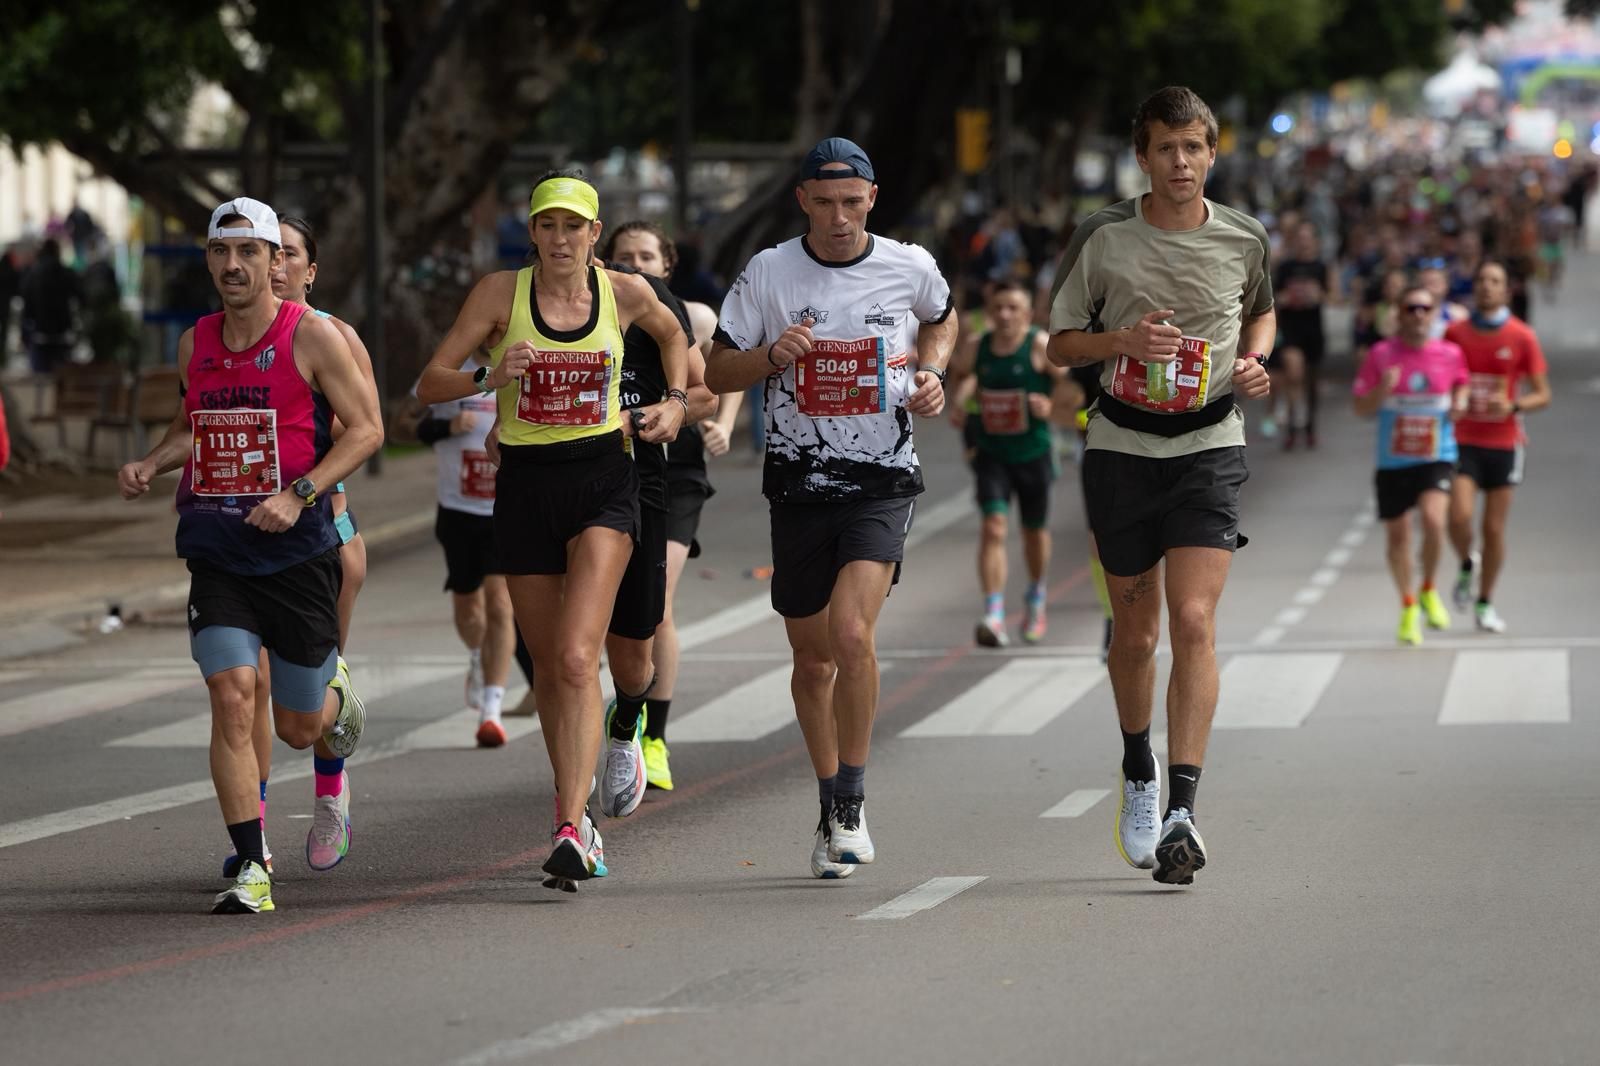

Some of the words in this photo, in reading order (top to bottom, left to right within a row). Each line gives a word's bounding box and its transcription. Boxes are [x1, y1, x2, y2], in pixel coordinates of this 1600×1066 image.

[818, 340, 871, 354] GENERALI
[544, 352, 600, 364] GENERALI
[815, 359, 858, 374] 5049
[537, 370, 591, 385] 11107
[552, 385, 571, 393] CLARA
[209, 414, 261, 426] GENERALI
[208, 432, 248, 449] 1118
